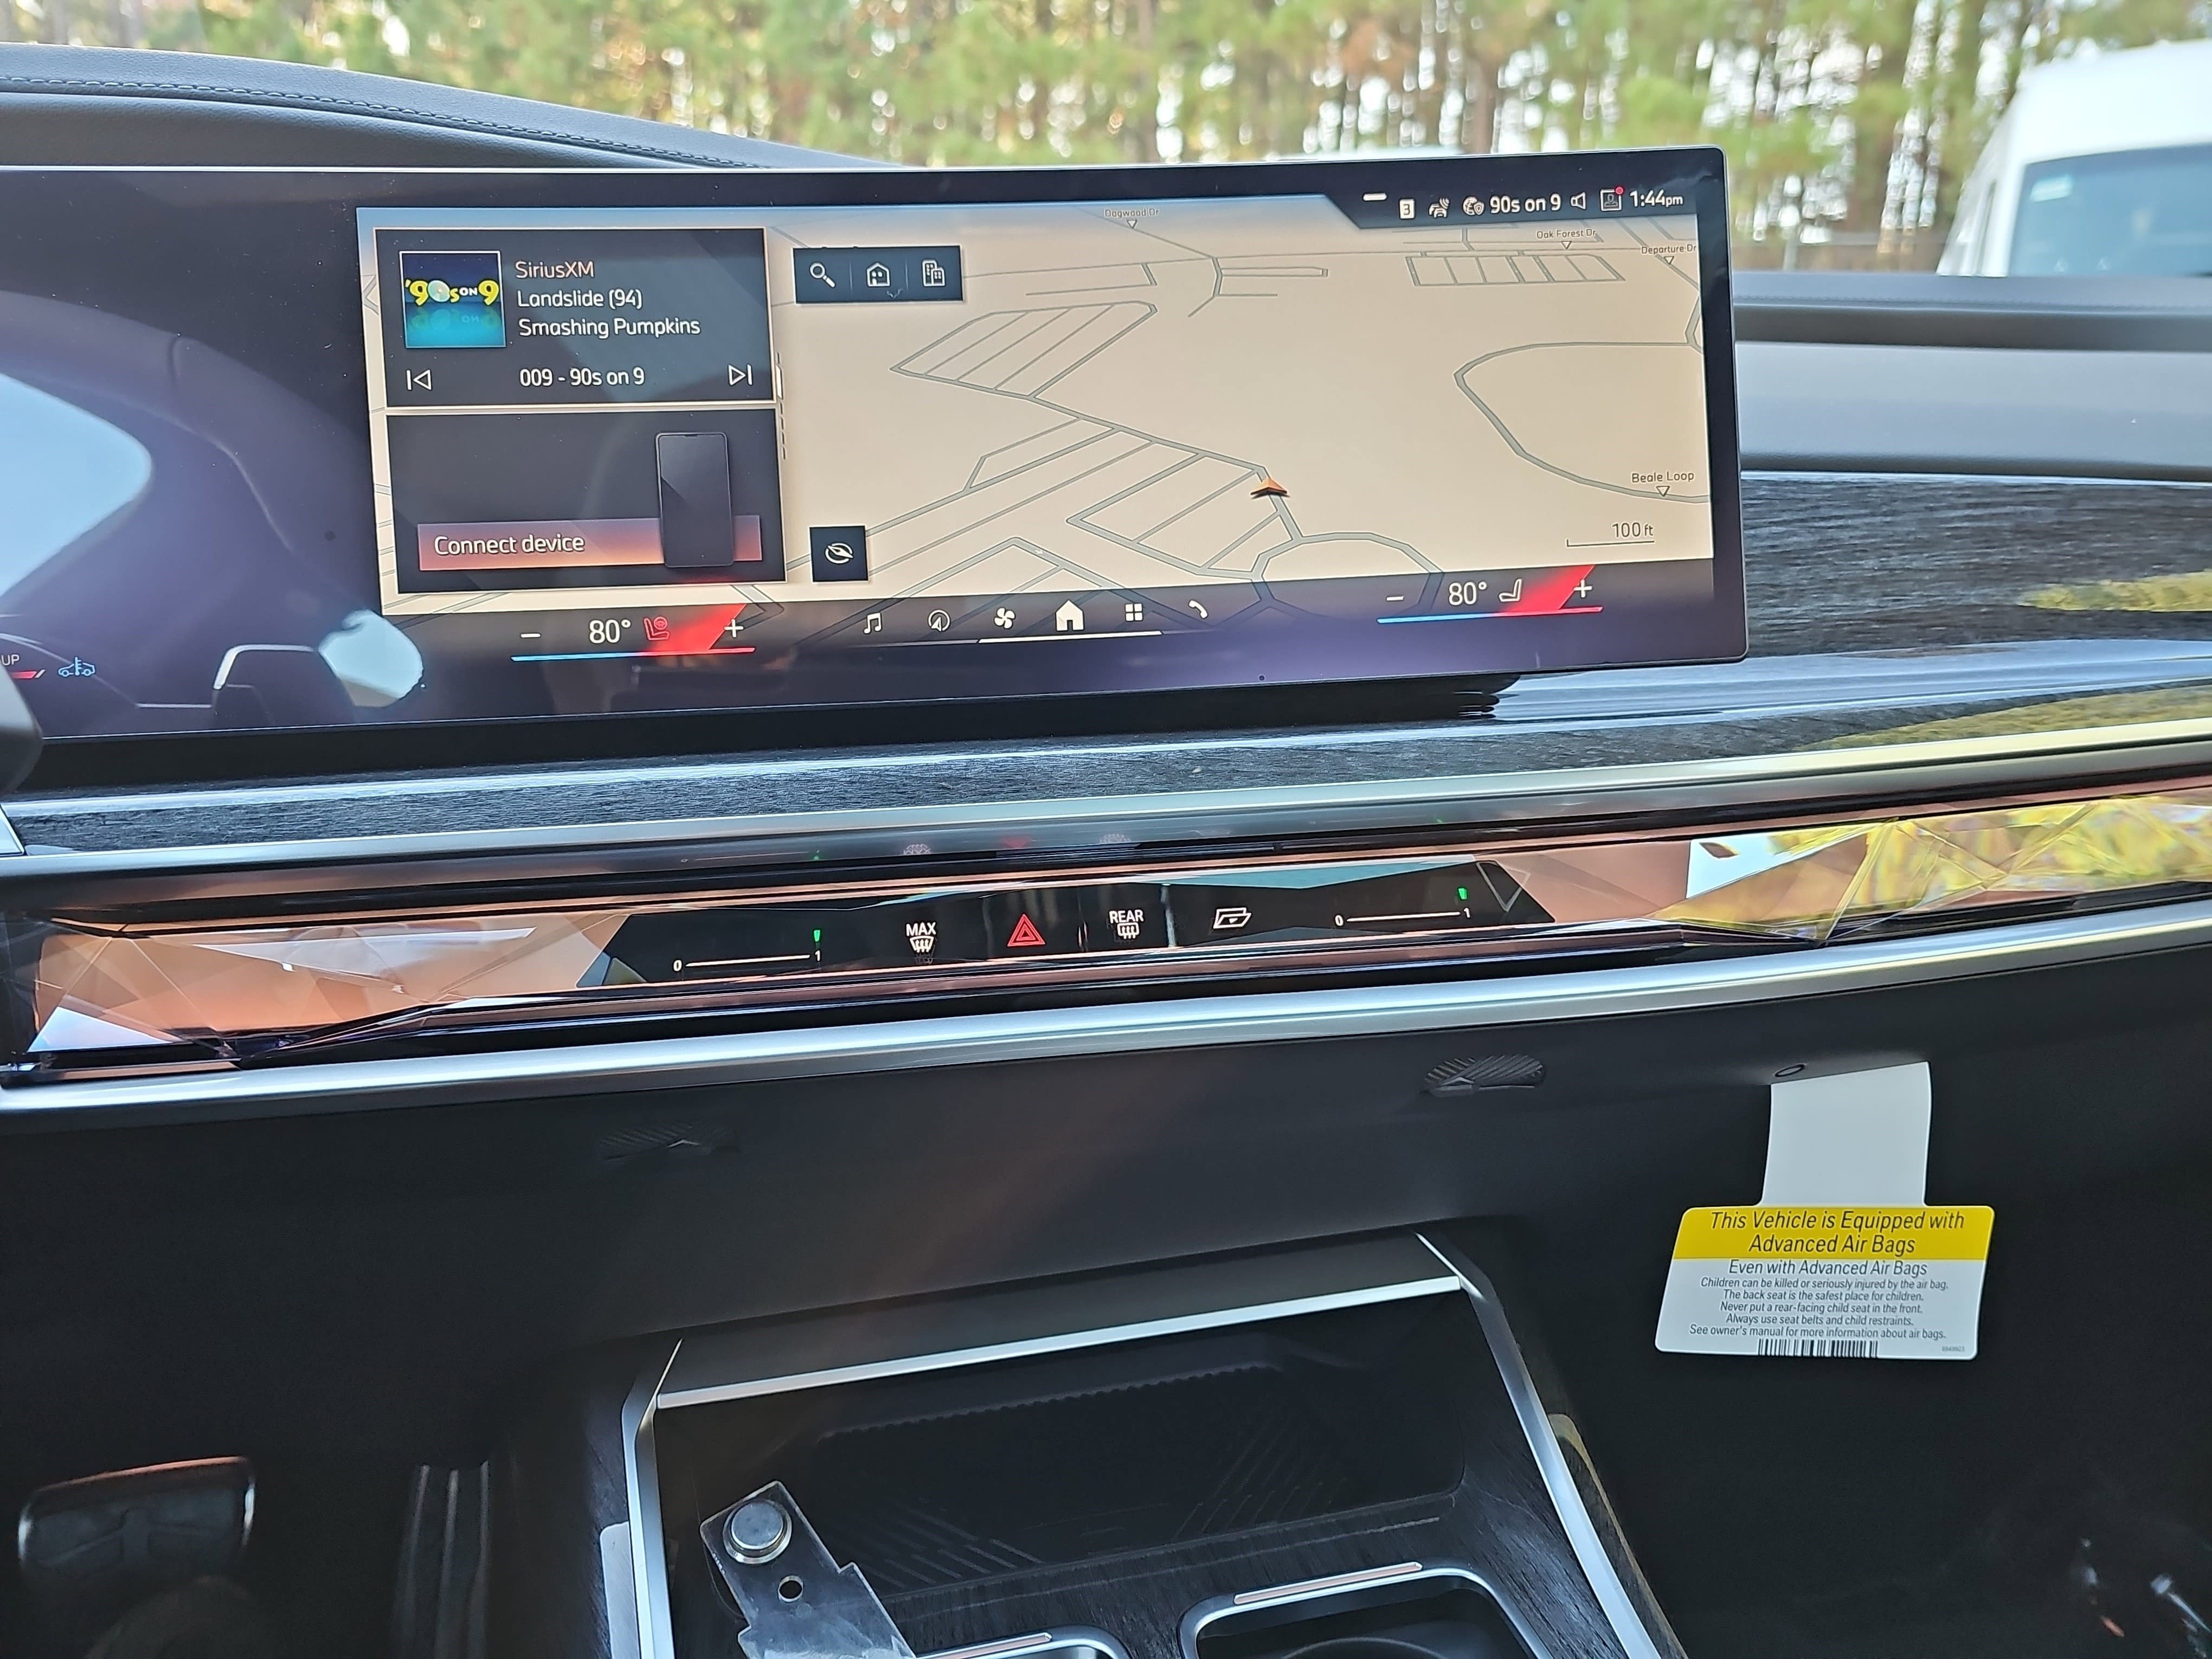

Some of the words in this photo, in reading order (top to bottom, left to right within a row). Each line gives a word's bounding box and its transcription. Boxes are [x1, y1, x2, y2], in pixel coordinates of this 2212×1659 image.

[1490, 196, 1520, 214] 90s
[1525, 198, 1546, 211] on
[1549, 194, 1561, 211] 9
[1629, 190, 1683, 208] 1:44pm
[1105, 208, 1146, 219] Dogwood
[1536, 230, 1553, 239] Oak
[1556, 229, 1584, 238] Forest
[1586, 228, 1596, 236] Dr
[1641, 246, 1684, 255] Departure
[515, 260, 595, 278] SiriusXM
[478, 280, 499, 306] 9
[517, 290, 604, 307] Landslide
[608, 288, 642, 310] (94)
[519, 318, 609, 339] Smashing
[613, 317, 701, 338] Pumpkins
[519, 369, 552, 386] 009
[569, 368, 602, 386] 90s
[607, 372, 629, 385] on
[633, 366, 645, 385] 9
[1631, 472, 1663, 484] Beale
[1666, 471, 1695, 483] Loop
[1611, 523, 1641, 539] 100
[1643, 524, 1654, 537] ft
[434, 535, 517, 556] Connect
[522, 533, 585, 554] device
[1448, 581, 1487, 606] 80°
[588, 618, 631, 644] 80°
[1, 653, 20, 666] UP
[1109, 909, 1144, 925] REAR
[1335, 915, 1344, 927] 0
[1463, 907, 1470, 918] 1
[906, 922, 937, 937] MAX
[673, 959, 682, 972] 0
[814, 949, 821, 961] 1
[1711, 1211, 1746, 1229] This
[1753, 1210, 1817, 1229] Vehicle
[1821, 1210, 1836, 1229] is
[1840, 1210, 1926, 1233] Equipped
[1930, 1210, 1965, 1229] with
[1748, 1233, 1838, 1252] Advanced
[1841, 1234, 1868, 1253] Air
[1872, 1234, 1915, 1257] Bags
[1728, 1259, 1763, 1274] Even
[1767, 1259, 1796, 1274] with
[1798, 1259, 1868, 1275] Advanced
[1870, 1260, 1891, 1275] Air
[1893, 1260, 1927, 1279] Bags
[1701, 1276, 1740, 1287] Children
[1742, 1279, 1759, 1288] can
[1761, 1277, 1772, 1288] be
[1774, 1277, 1799, 1288] killed
[1800, 1280, 1810, 1288] or
[1812, 1278, 1853, 1290] seriously
[1854, 1279, 1887, 1290] injured
[1887, 1279, 1898, 1290] by
[1900, 1279, 1915, 1289] the
[1916, 1279, 1927, 1289] air
[1930, 1279, 1949, 1291] bag.
[1724, 1289, 1741, 1299] The
[1743, 1289, 1764, 1300] back
[1766, 1290, 1787, 1300] seat
[1789, 1290, 1796, 1300] is
[1798, 1290, 1813, 1300] the
[1815, 1290, 1843, 1301] safest
[1844, 1290, 1869, 1302] place
[1871, 1290, 1884, 1301] for
[1885, 1291, 1924, 1301] children.
[1720, 1301, 1748, 1311] Never
[1749, 1302, 1765, 1314] put
[1774, 1302, 1825, 1315] rear-facing
[1827, 1303, 1849, 1313] child
[1850, 1304, 1871, 1313] seat
[1872, 1303, 1881, 1313] in
[1882, 1303, 1897, 1313] the
[1899, 1303, 1923, 1314] front.
[1726, 1313, 1759, 1326] Always
[1761, 1316, 1778, 1324] use
[1779, 1315, 1799, 1324] seat
[1801, 1315, 1823, 1325] belts
[1825, 1315, 1843, 1325] and
[1844, 1315, 1867, 1326] child
[1868, 1316, 1914, 1326] restraints.
[1689, 1323, 1708, 1335] See
[1710, 1325, 1747, 1335] owner's
[1749, 1326, 1783, 1336] manual
[1785, 1326, 1798, 1336] for
[1800, 1328, 1824, 1337] more
[1825, 1327, 1879, 1338] information
[1880, 1328, 1907, 1338] about
[1908, 1328, 1920, 1338] air
[1922, 1328, 1946, 1341] bags.
